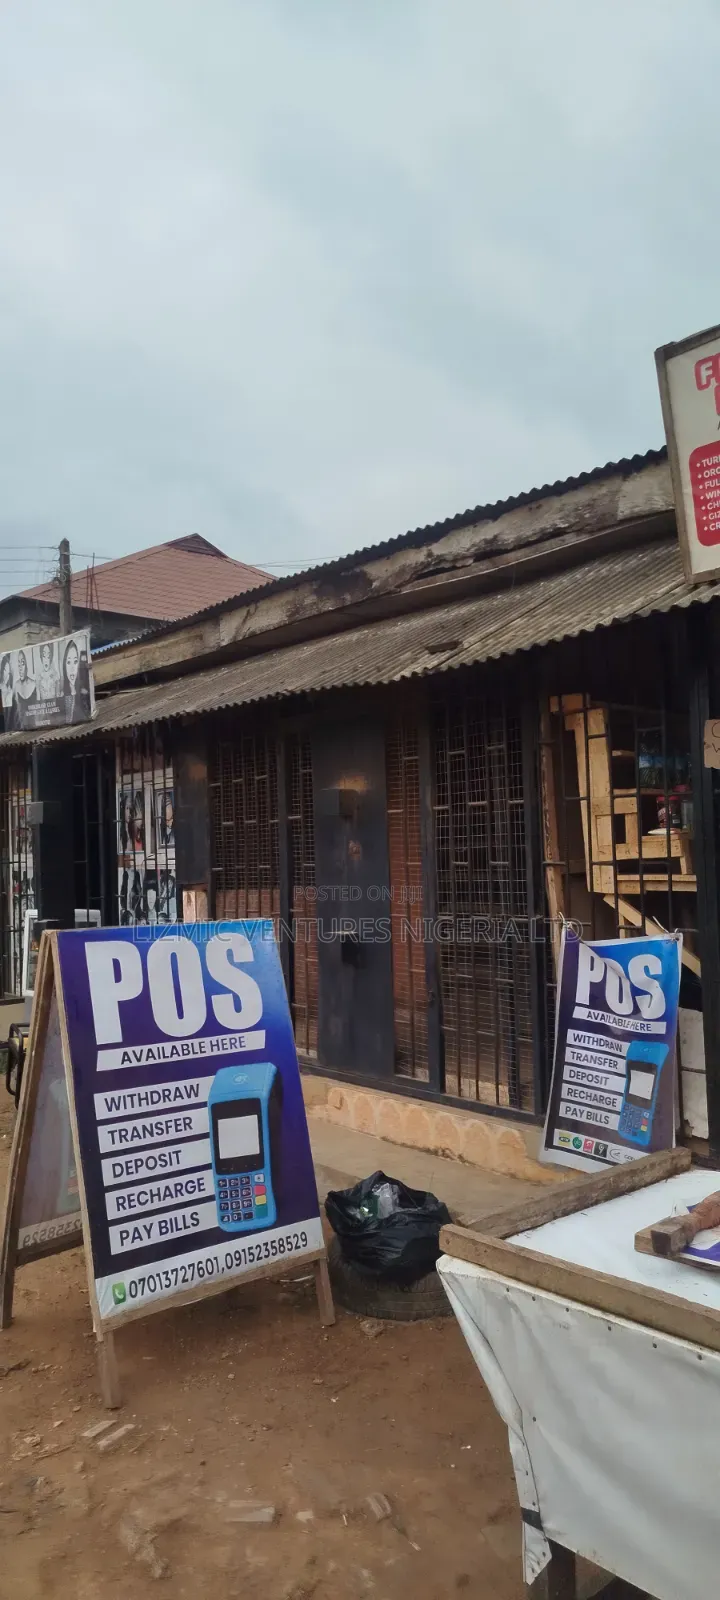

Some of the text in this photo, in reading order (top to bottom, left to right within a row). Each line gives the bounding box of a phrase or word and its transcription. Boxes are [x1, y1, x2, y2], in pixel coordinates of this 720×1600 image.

[707, 500, 720, 510] CH
[85, 932, 263, 1045] POS
[575, 942, 666, 1019] POS
[120, 1035, 246, 1065] AVAILABLE HERE
[572, 1032, 623, 1053] WITHDRAW
[570, 1051, 619, 1070] TRANSFER
[568, 1069, 610, 1086] DEPOSIT
[104, 1083, 200, 1113] WITHDRAW
[566, 1087, 618, 1108] RECHARGE
[564, 1105, 610, 1125] PAY BILLS
[107, 1116, 193, 1145] TRANSFER
[111, 1149, 182, 1178] DEPOSIT
[115, 1177, 206, 1212] RECHARGE
[119, 1211, 200, 1247] PAY BILLS
